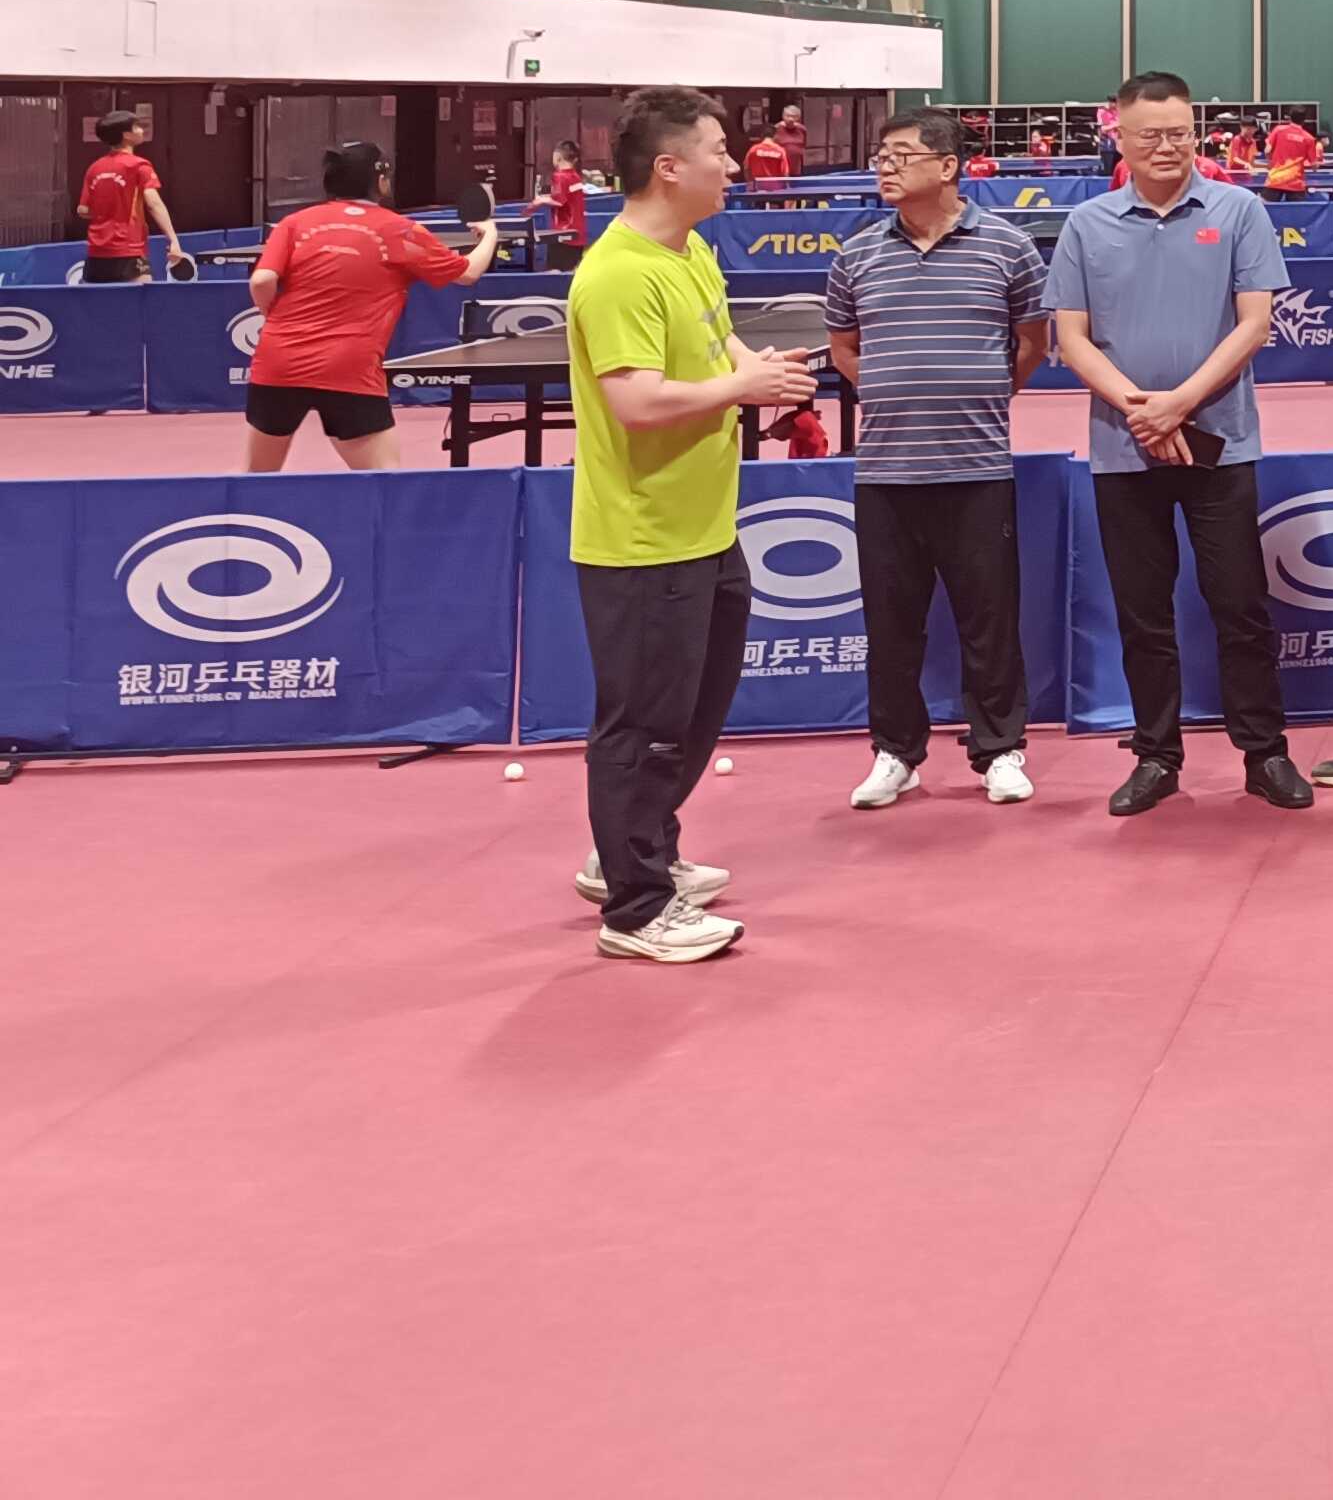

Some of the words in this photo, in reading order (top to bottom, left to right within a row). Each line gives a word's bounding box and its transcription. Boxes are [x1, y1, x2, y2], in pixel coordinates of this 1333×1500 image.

[416, 375, 472, 386] YINHE
[118, 656, 341, 695] 银河乒乓器材
[247, 689, 282, 700] MADE
[284, 688, 298, 698] IN
[299, 687, 337, 699] CHINA
